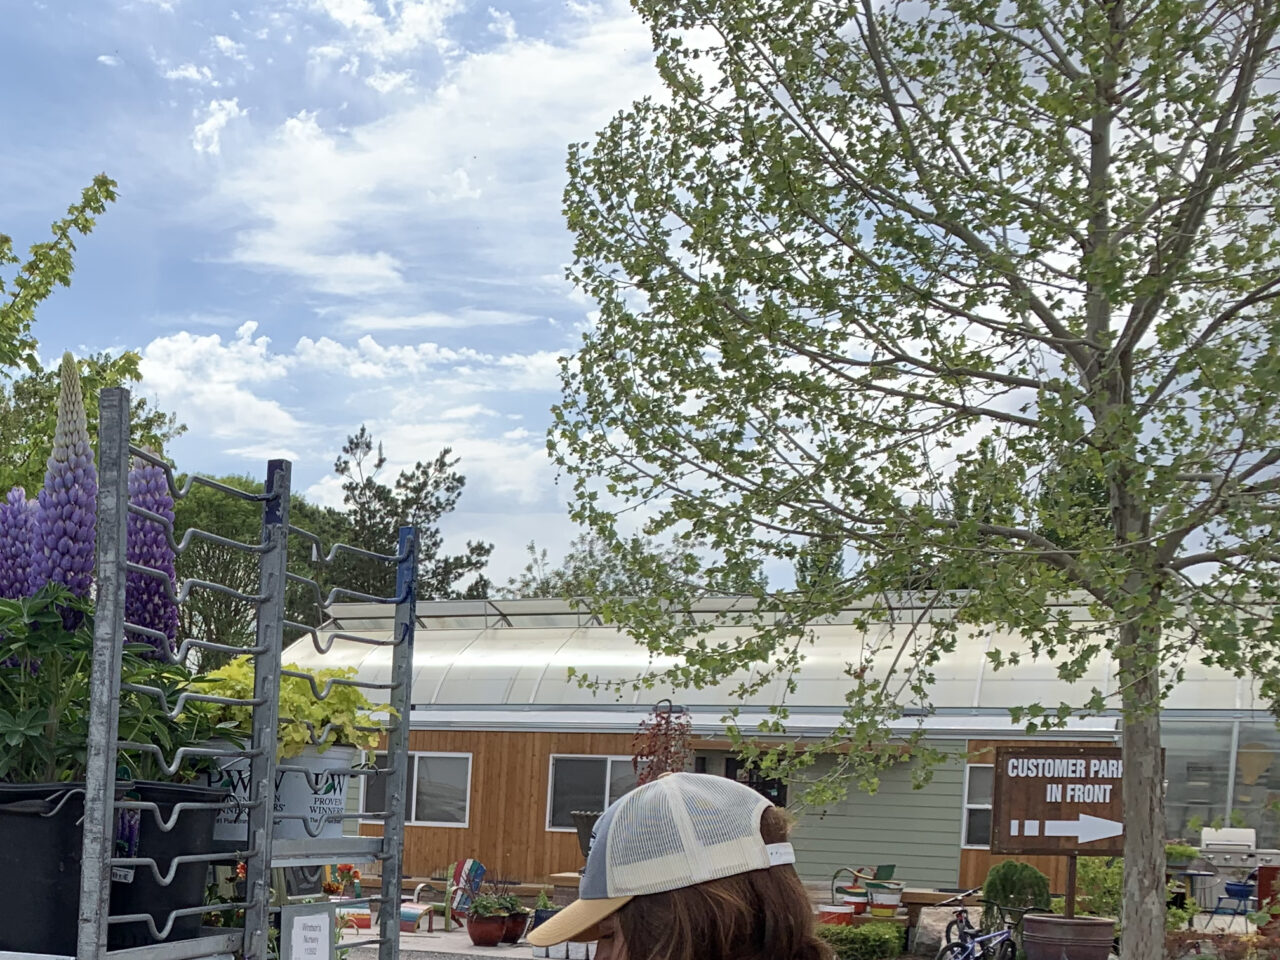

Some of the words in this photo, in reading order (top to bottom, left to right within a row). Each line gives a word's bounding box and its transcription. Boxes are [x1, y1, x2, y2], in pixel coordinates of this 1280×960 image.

[1007, 758, 1086, 778] CUSTOMER
[1046, 784, 1062, 803] IN
[1066, 784, 1113, 804] FRONT
